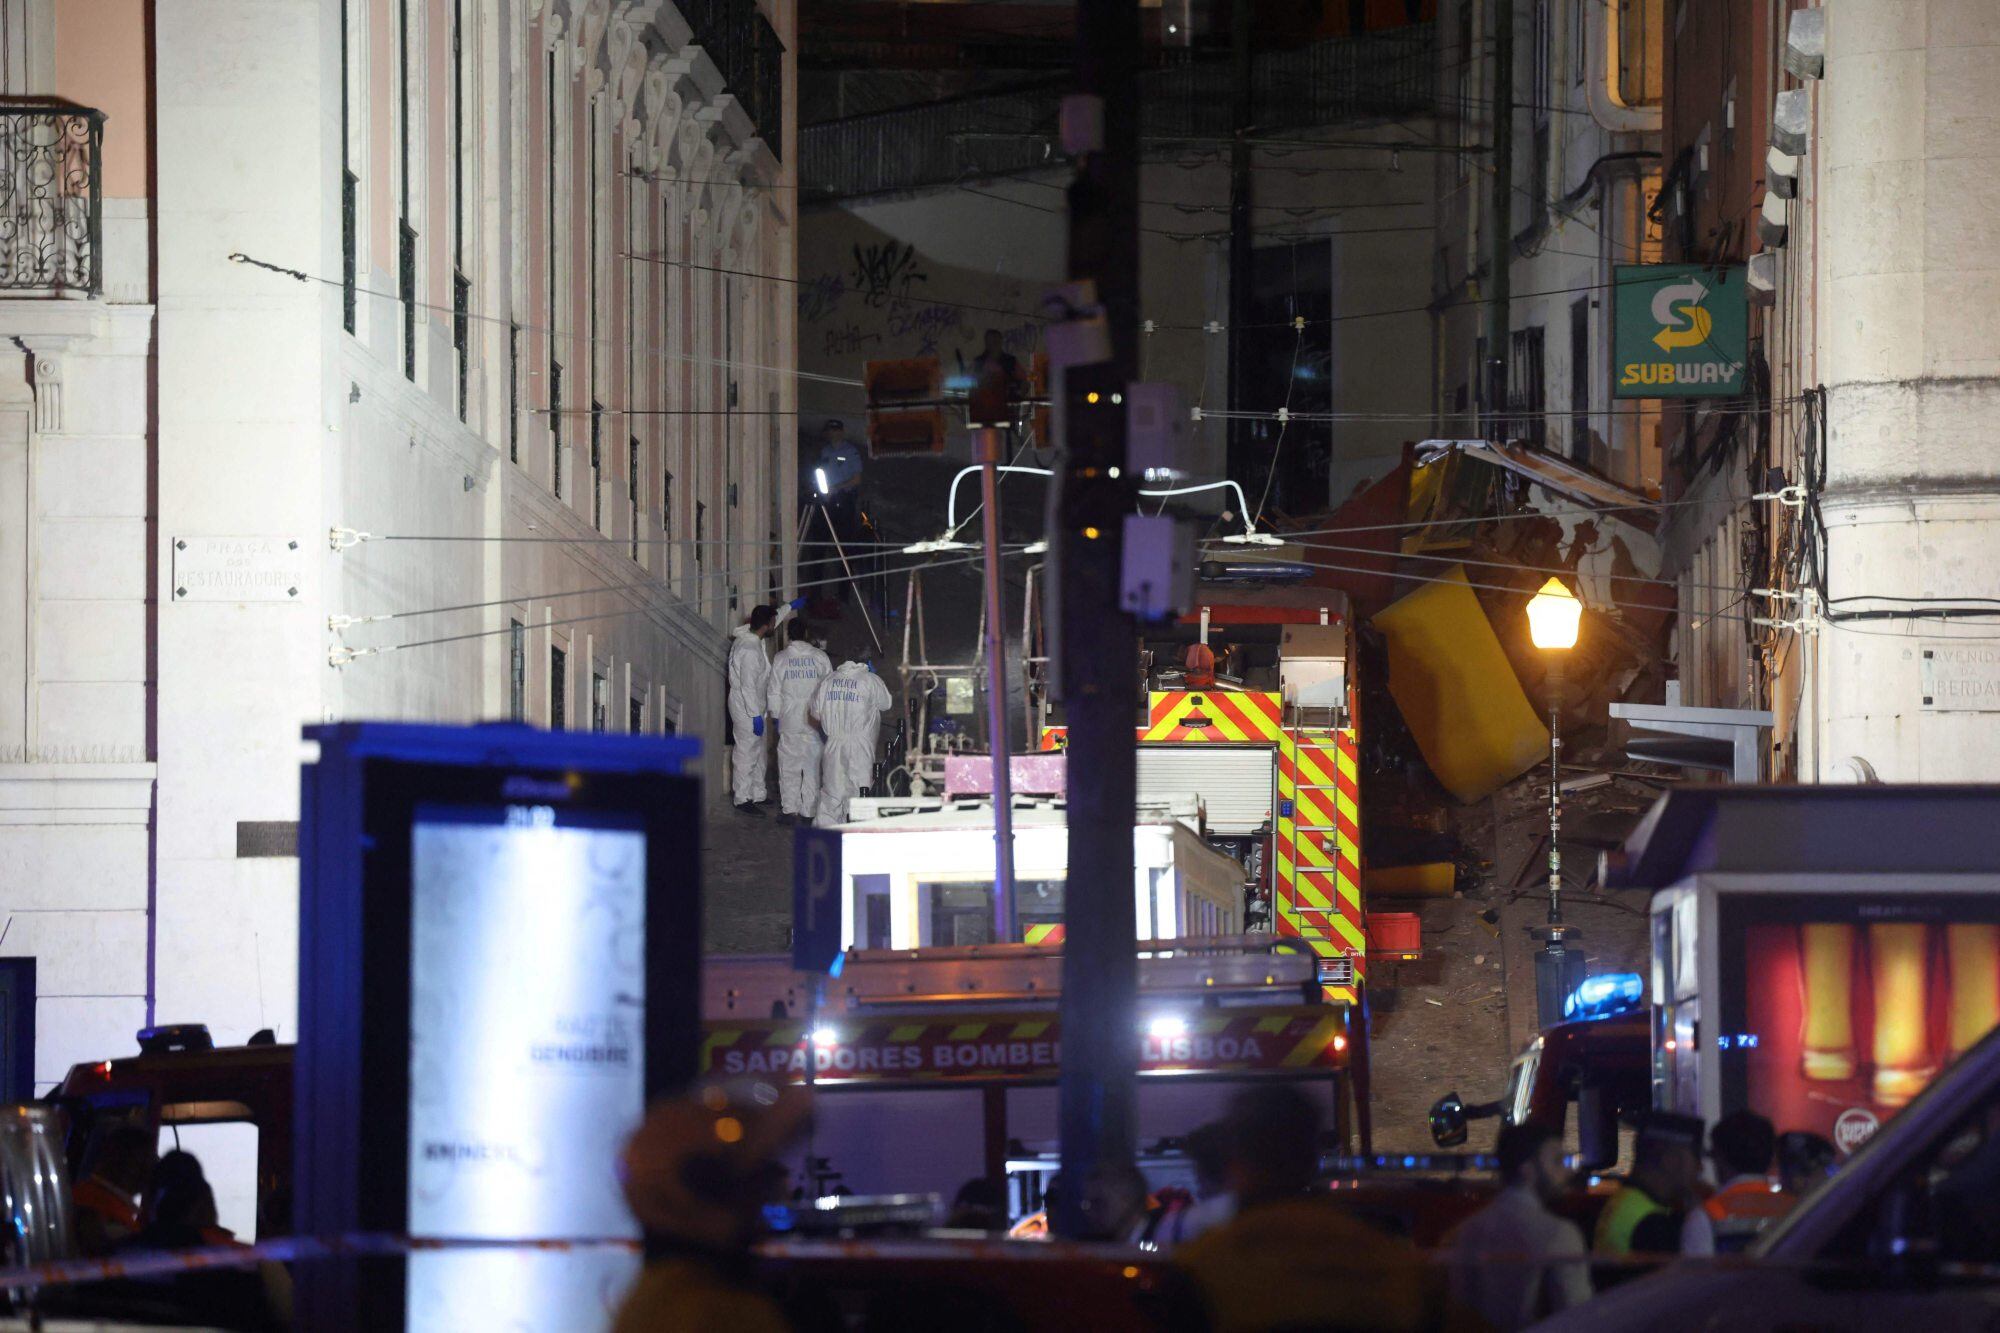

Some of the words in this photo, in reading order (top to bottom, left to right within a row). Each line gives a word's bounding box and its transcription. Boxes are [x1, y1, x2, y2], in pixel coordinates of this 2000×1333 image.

[1620, 361, 1743, 386] SUBWAY
[206, 542, 272, 557] PRAÇA
[177, 570, 302, 587] RESTAURADORES
[724, 1045, 923, 1074] SAPADORES
[1141, 1037, 1263, 1061] LISBOA
